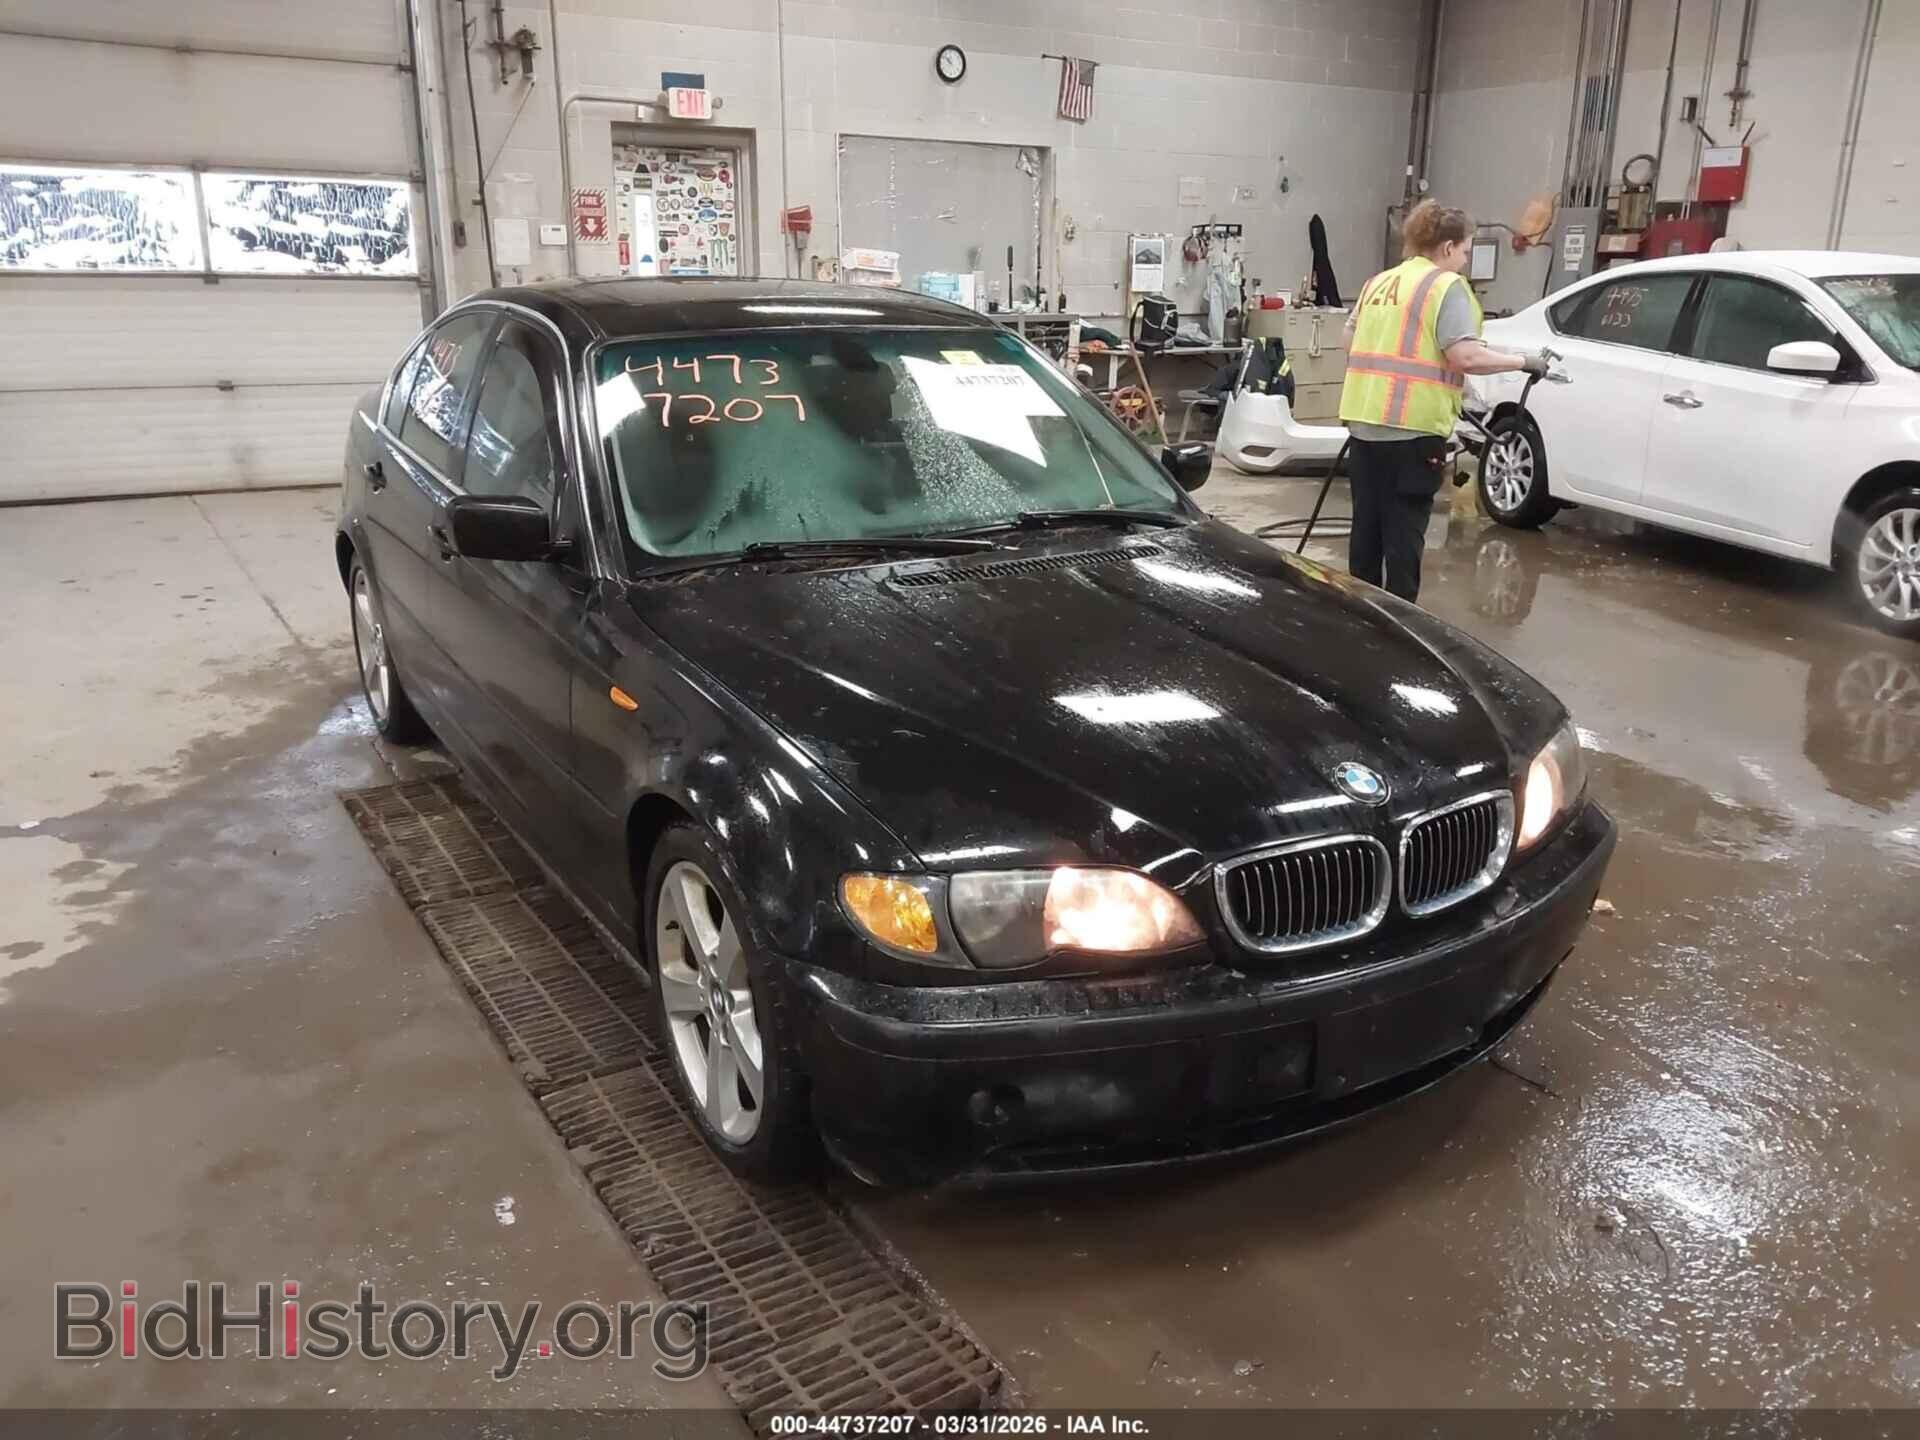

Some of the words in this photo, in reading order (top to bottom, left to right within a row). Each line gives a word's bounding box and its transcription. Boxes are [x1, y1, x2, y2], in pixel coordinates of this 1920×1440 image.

[676, 89, 705, 116] EXIT
[580, 196, 599, 205] FIRE
[624, 354, 780, 387] 4473
[643, 392, 807, 428] 7207
